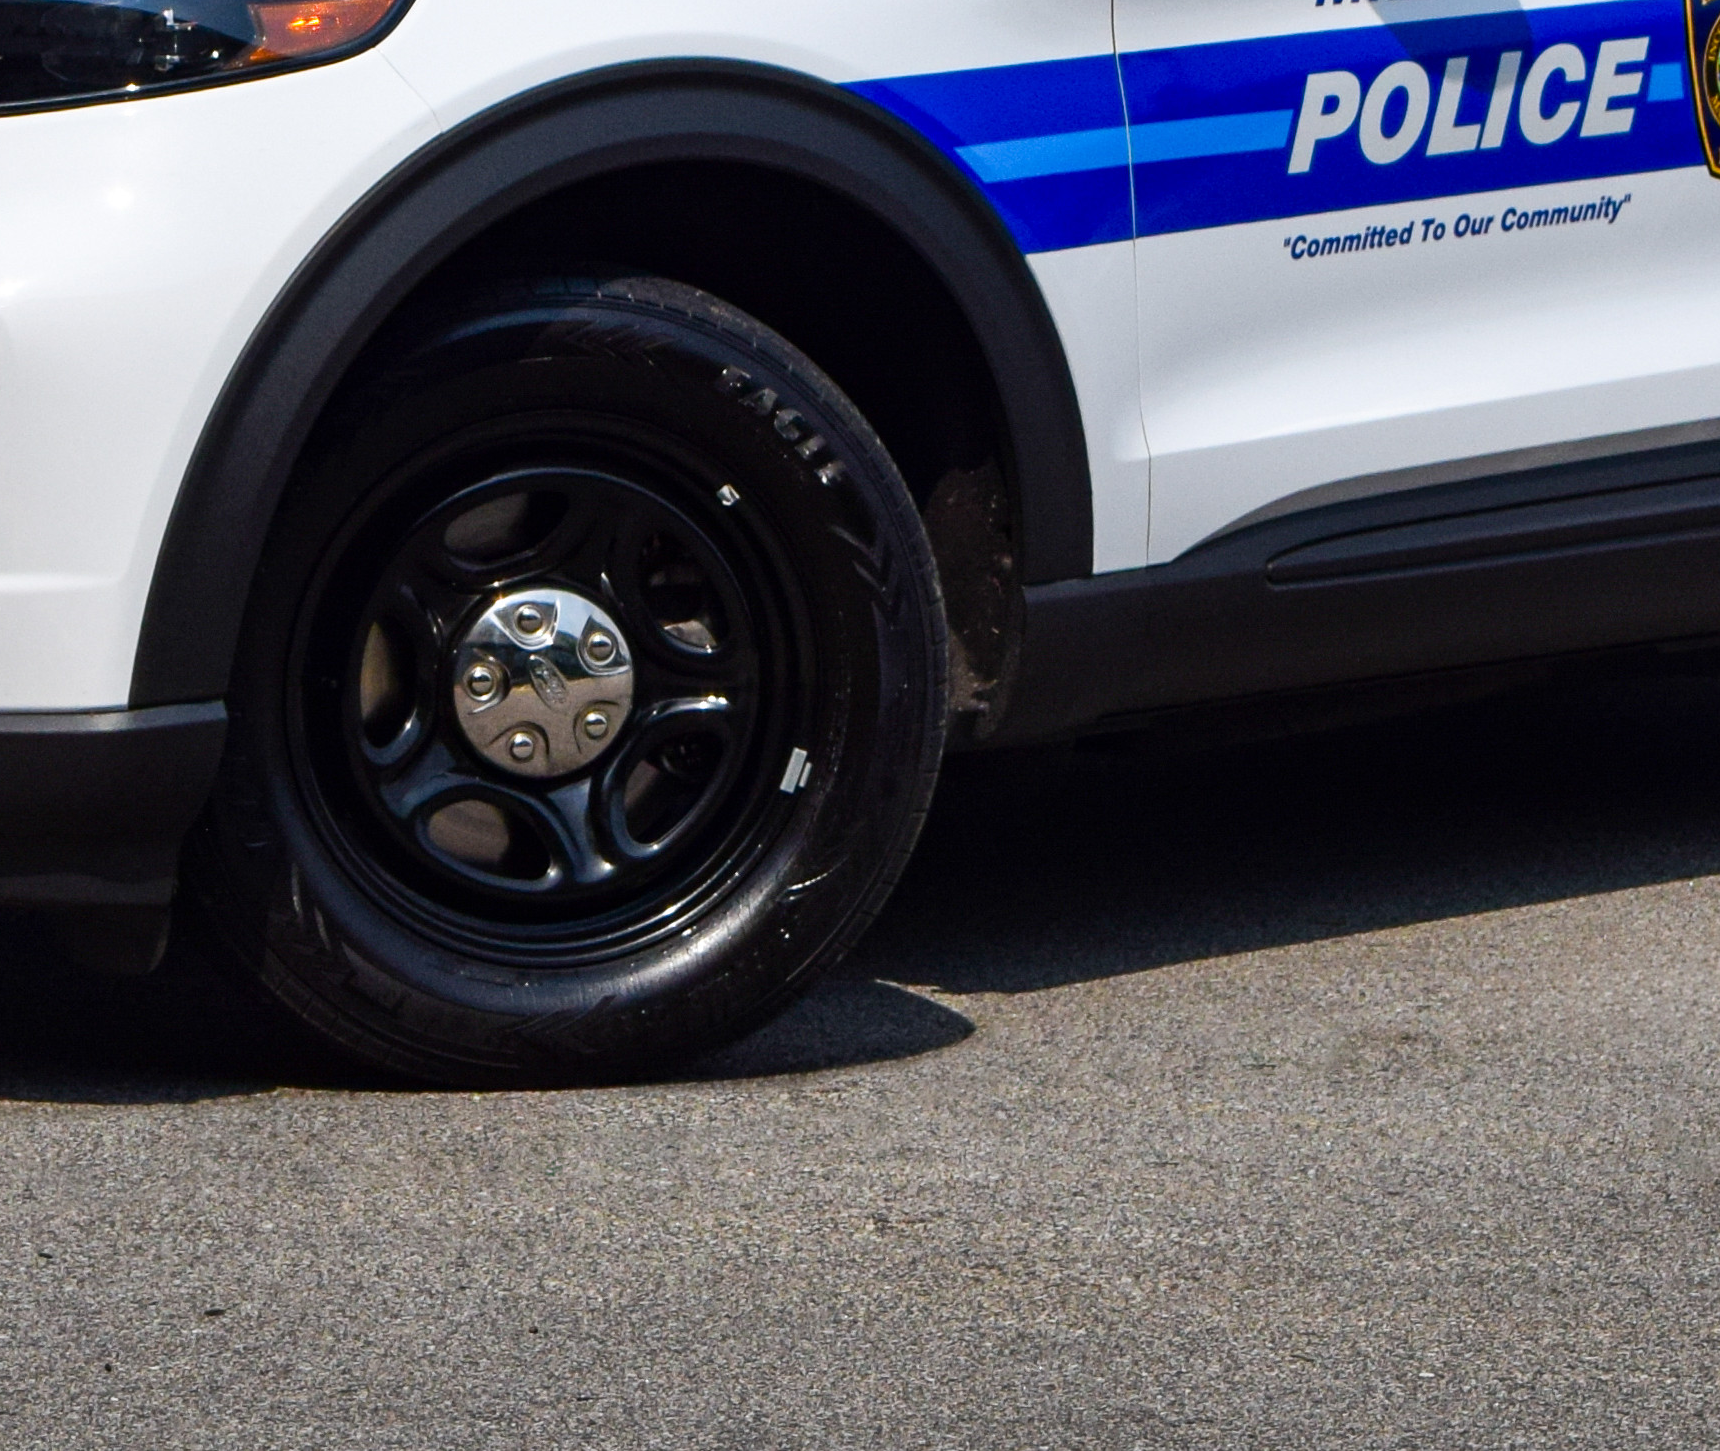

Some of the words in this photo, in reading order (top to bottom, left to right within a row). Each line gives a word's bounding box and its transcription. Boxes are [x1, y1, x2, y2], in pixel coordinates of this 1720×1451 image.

[1287, 36, 1650, 176] POLICE
[1421, 218, 1446, 242] To
[1453, 214, 1494, 238] Our
